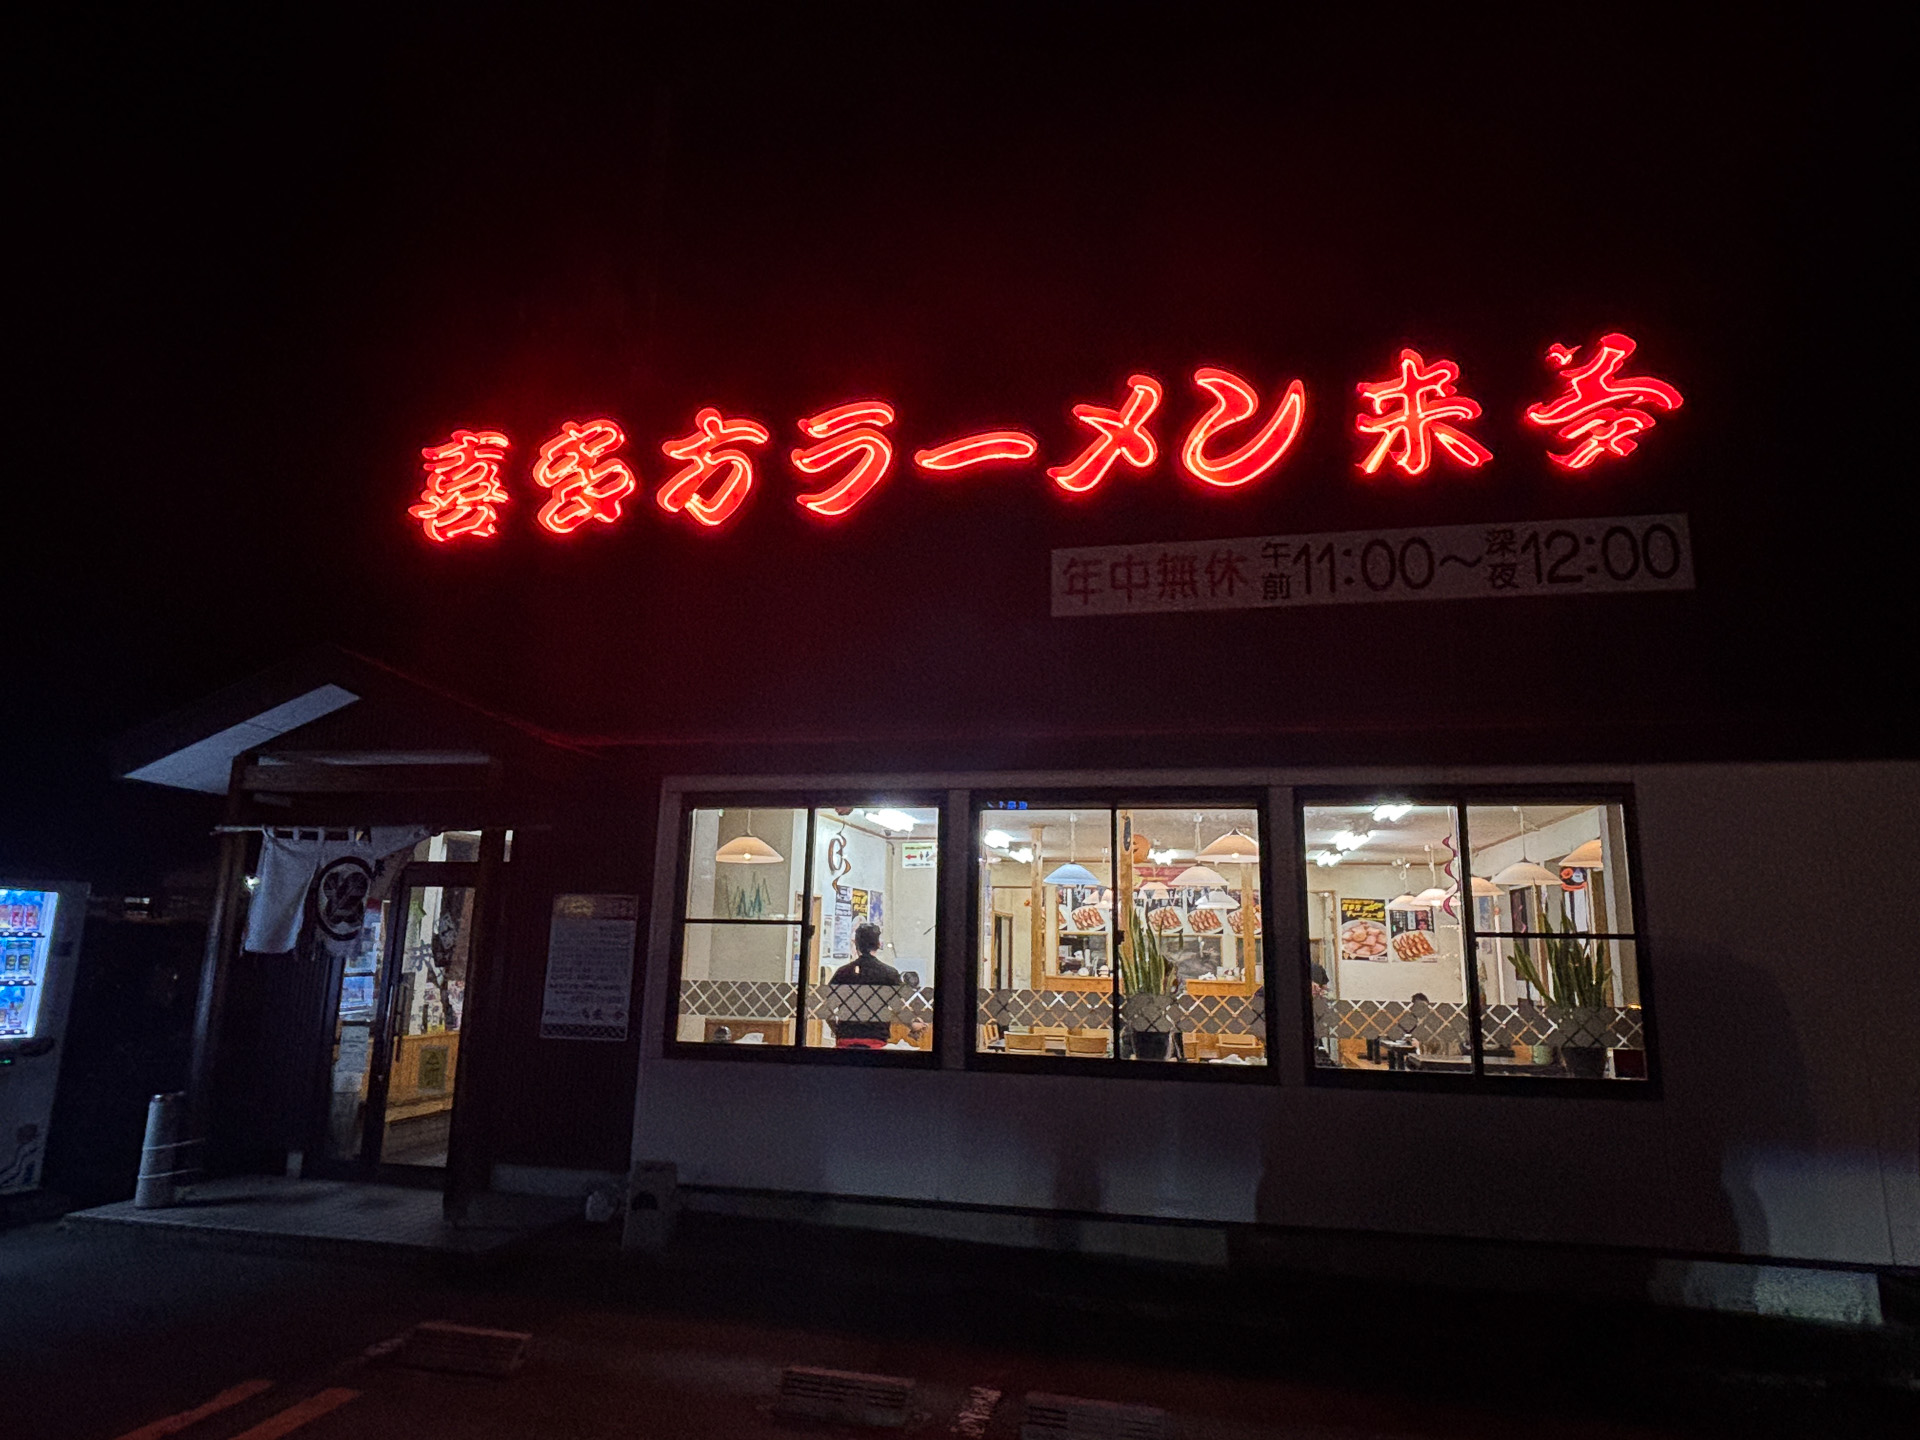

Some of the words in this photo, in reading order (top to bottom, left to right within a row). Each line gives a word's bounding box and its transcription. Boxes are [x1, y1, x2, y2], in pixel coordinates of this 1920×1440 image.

[408, 367, 1306, 542] 喜多方ラーメン
[1062, 549, 1250, 605] 年中無休
